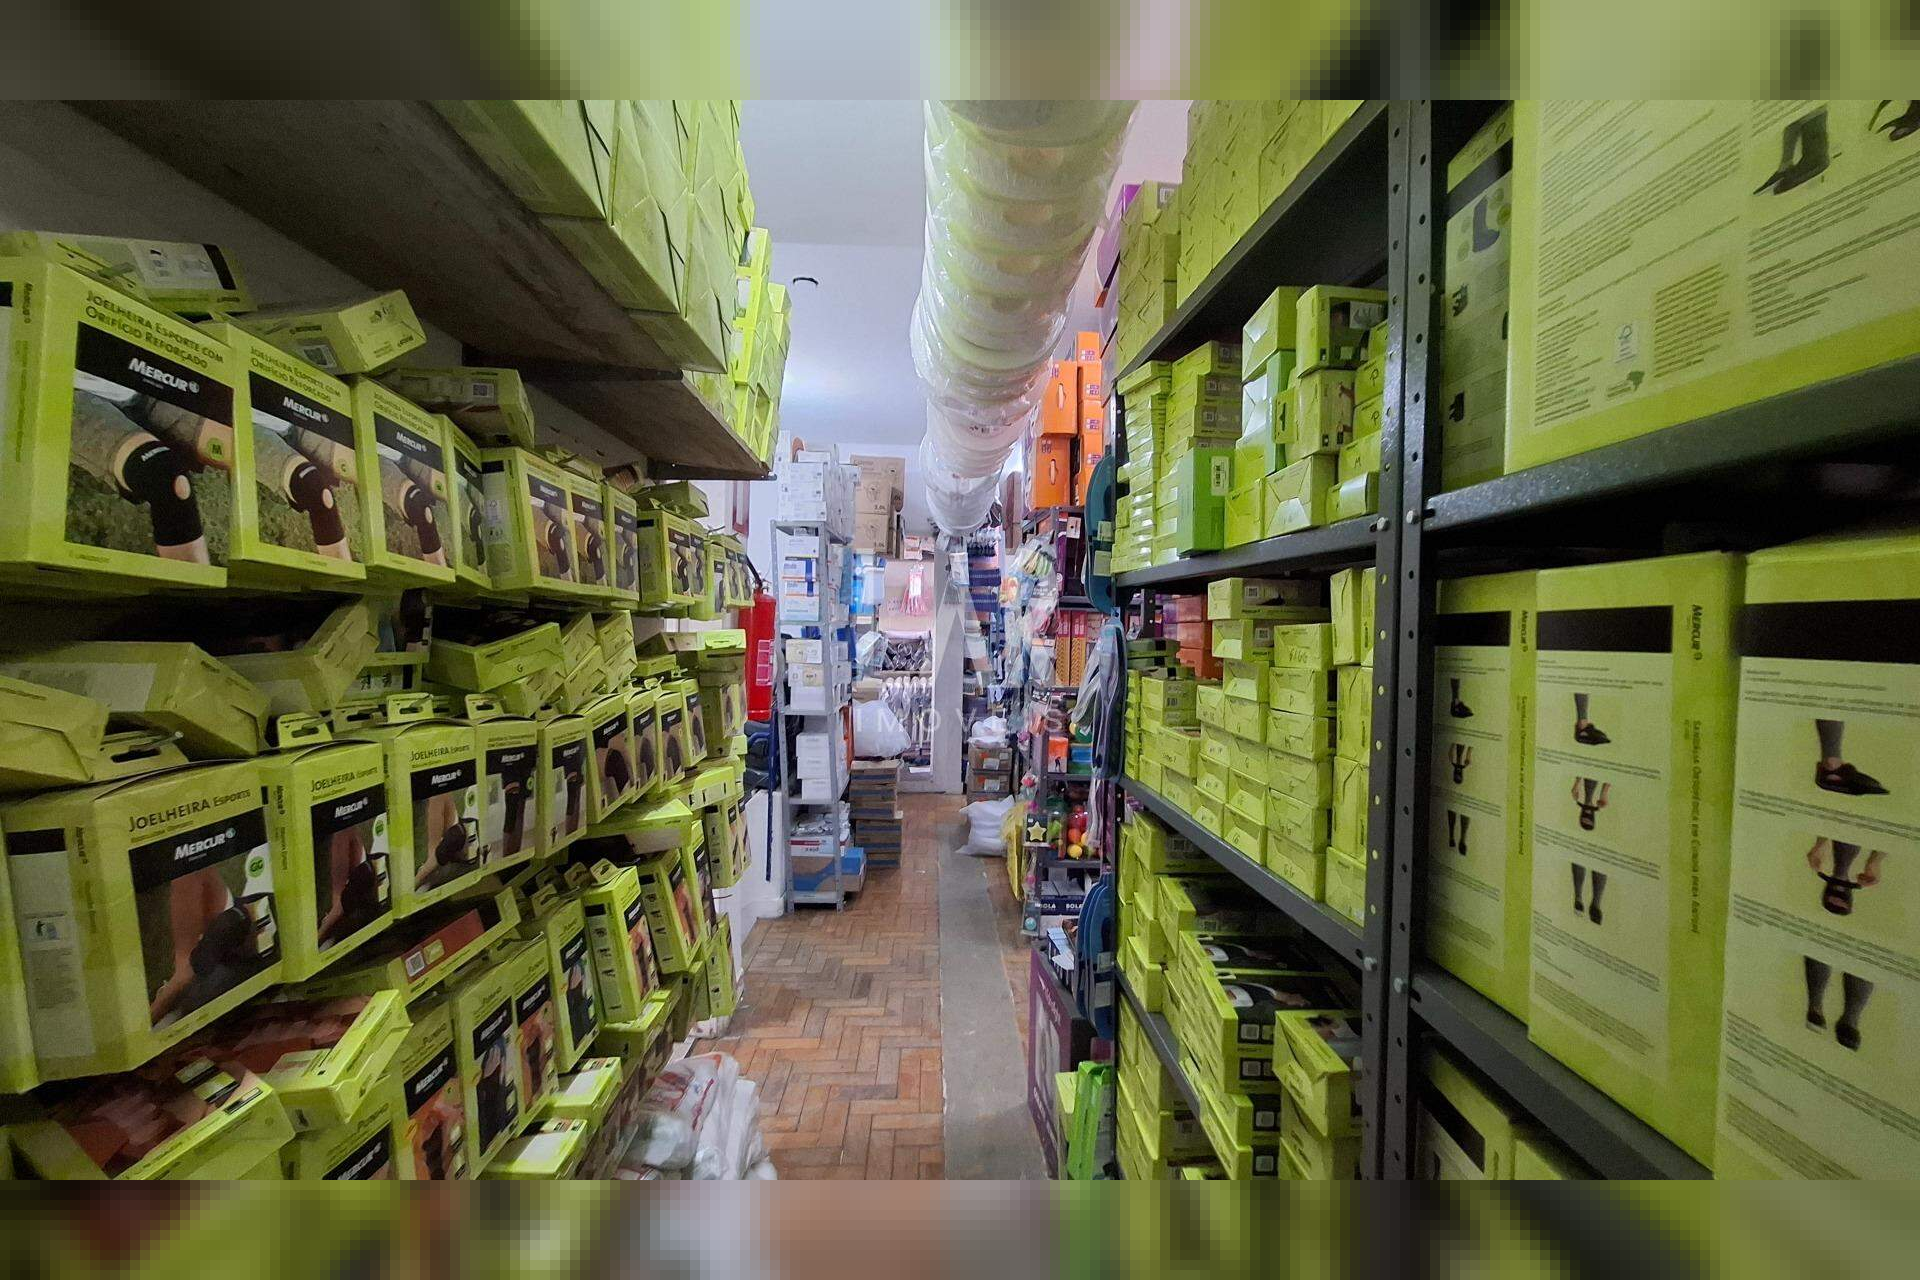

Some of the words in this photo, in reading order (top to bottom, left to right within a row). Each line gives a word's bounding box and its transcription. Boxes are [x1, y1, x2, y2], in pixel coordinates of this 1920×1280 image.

[86, 290, 152, 331] JOELHEIRA
[155, 322, 200, 352] ESPORTE
[201, 346, 224, 364] COM
[145, 331, 208, 370] REFORÇADO
[128, 357, 189, 393] MERCUR
[283, 396, 322, 422] MERCUR
[1692, 604, 1703, 650] MERCUR
[409, 746, 450, 763] JOELHEIRA
[310, 771, 356, 793] JOELHEIRA
[431, 773, 457, 786] MERCUR
[128, 797, 210, 833] JOELHEIRA
[212, 788, 252, 808] ESPORTE
[334, 800, 362, 819] MERCUR
[174, 833, 226, 861] MERCUR
[415, 1064, 443, 1094] MERCUR
